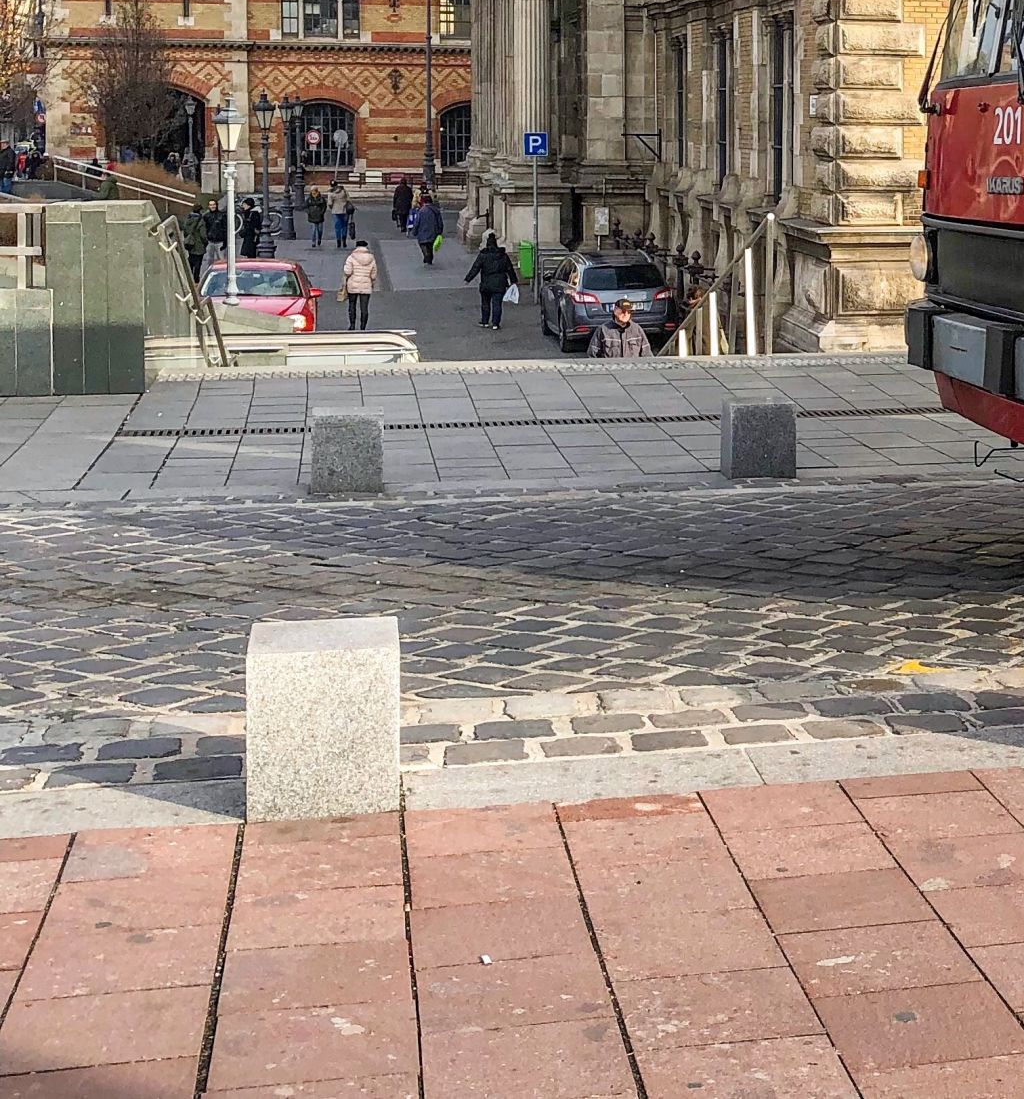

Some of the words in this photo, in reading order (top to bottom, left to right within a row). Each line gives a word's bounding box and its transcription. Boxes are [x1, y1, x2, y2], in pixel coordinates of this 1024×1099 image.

[993, 106, 1022, 145] 201
[529, 135, 542, 153] P
[986, 176, 1024, 195] IKARUS
